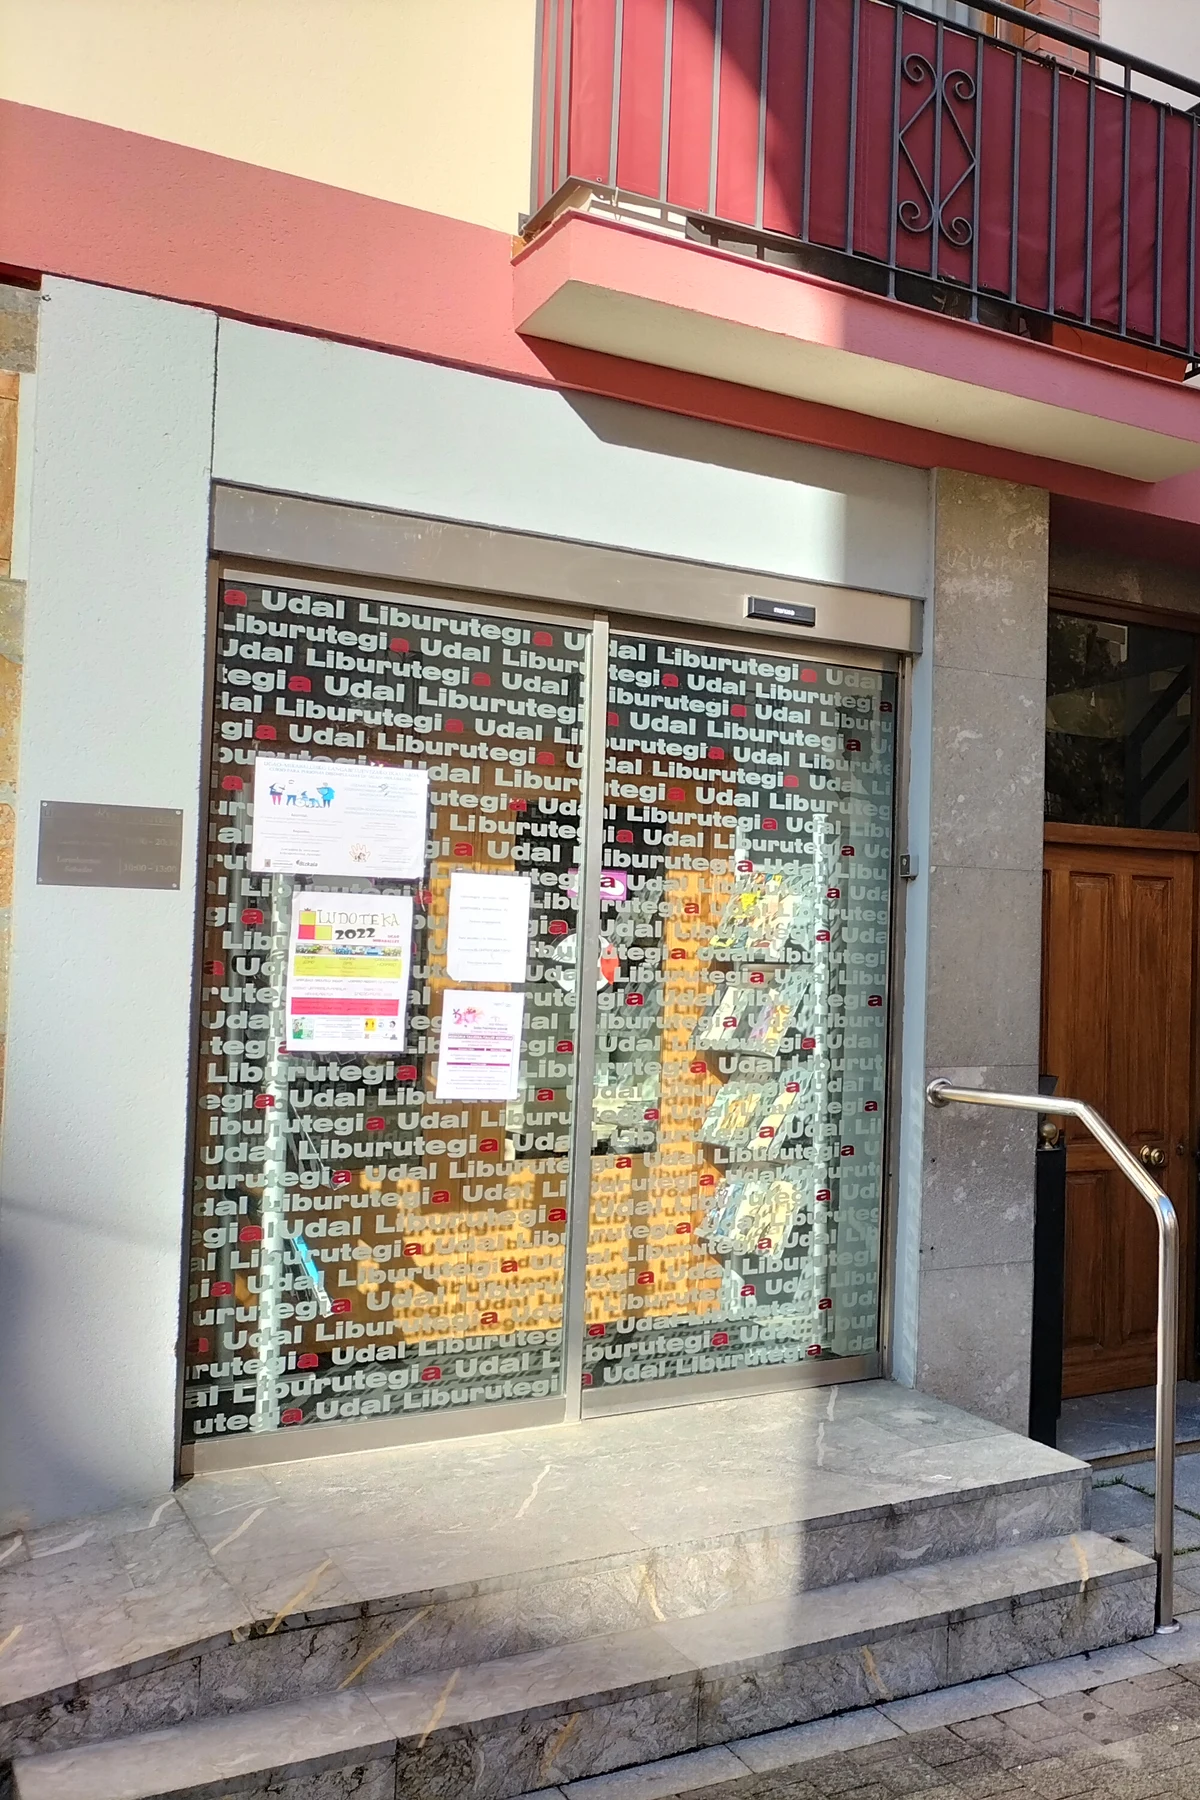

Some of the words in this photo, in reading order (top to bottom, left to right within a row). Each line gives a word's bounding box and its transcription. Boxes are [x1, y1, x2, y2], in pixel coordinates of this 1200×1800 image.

[261, 587, 345, 621] Udal
[358, 601, 553, 651] Liburutegia
[420, 636, 490, 663] Udal
[305, 644, 491, 691] Liburutegia
[502, 670, 575, 698] Udal
[657, 642, 817, 687] Liburutegia
[826, 667, 882, 692] Udal
[324, 673, 405, 704] Udal
[608, 663, 678, 692] tegia
[687, 672, 746, 697] Udal
[755, 679, 892, 717] Liburutegia
[275, 694, 464, 737] Liburutegia
[474, 716, 542, 742] Udal
[608, 683, 747, 722] iburutegia
[755, 702, 810, 726] Udal
[214, 715, 277, 745] gia
[288, 723, 365, 750] Udal
[376, 729, 555, 770] Liburutegia
[606, 730, 725, 764] urutegia
[732, 744, 790, 767] Udal
[629, 710, 696, 737] Udal
[707, 717, 861, 756] Liburutegia
[494, 767, 582, 794] Libur
[652, 758, 799, 792] Liburutegia
[809, 774, 862, 794] Udal
[695, 786, 759, 809] Udal
[450, 812, 580, 841] Liburute
[626, 803, 778, 835] Liburutegia
[785, 815, 841, 836] Udal
[487, 839, 560, 863] Udal
[643, 827, 703, 849] Udal
[713, 831, 855, 860] Liburutegia
[626, 872, 688, 894] Udal
[335, 927, 376, 940] 2022
[598, 1034, 660, 1052] Udal
[826, 1033, 878, 1049] Udal
[207, 1060, 418, 1084] Liburutegia
[719, 1055, 780, 1073] Udal
[289, 1087, 365, 1107] Udal
[397, 1111, 468, 1130] Udal
[200, 1141, 284, 1164] Udal
[298, 1134, 498, 1160] Liburutegia
[714, 1141, 854, 1164] Liburutegia
[364, 1163, 436, 1182] Udal
[261, 1186, 450, 1213] Liburutegia
[462, 1182, 532, 1202] Udal
[280, 1215, 361, 1239] Udal
[375, 1203, 567, 1235] Liburutegia
[230, 1238, 422, 1269] Liburutegia
[247, 1270, 325, 1294] Udal
[337, 1255, 519, 1289] Liburutegia
[666, 1259, 731, 1282] Udal
[365, 1286, 444, 1311] Udal
[223, 1324, 303, 1351] Udal
[315, 1305, 499, 1343] Liburutegia
[331, 1341, 406, 1366] Udal
[585, 1329, 729, 1366] burutegia
[233, 1360, 442, 1404] Liburutegia
[455, 1351, 529, 1378] Udal
[602, 1360, 665, 1385] Udal
[315, 1393, 390, 1420] Udal
[403, 1373, 558, 1412] Liburutegi
